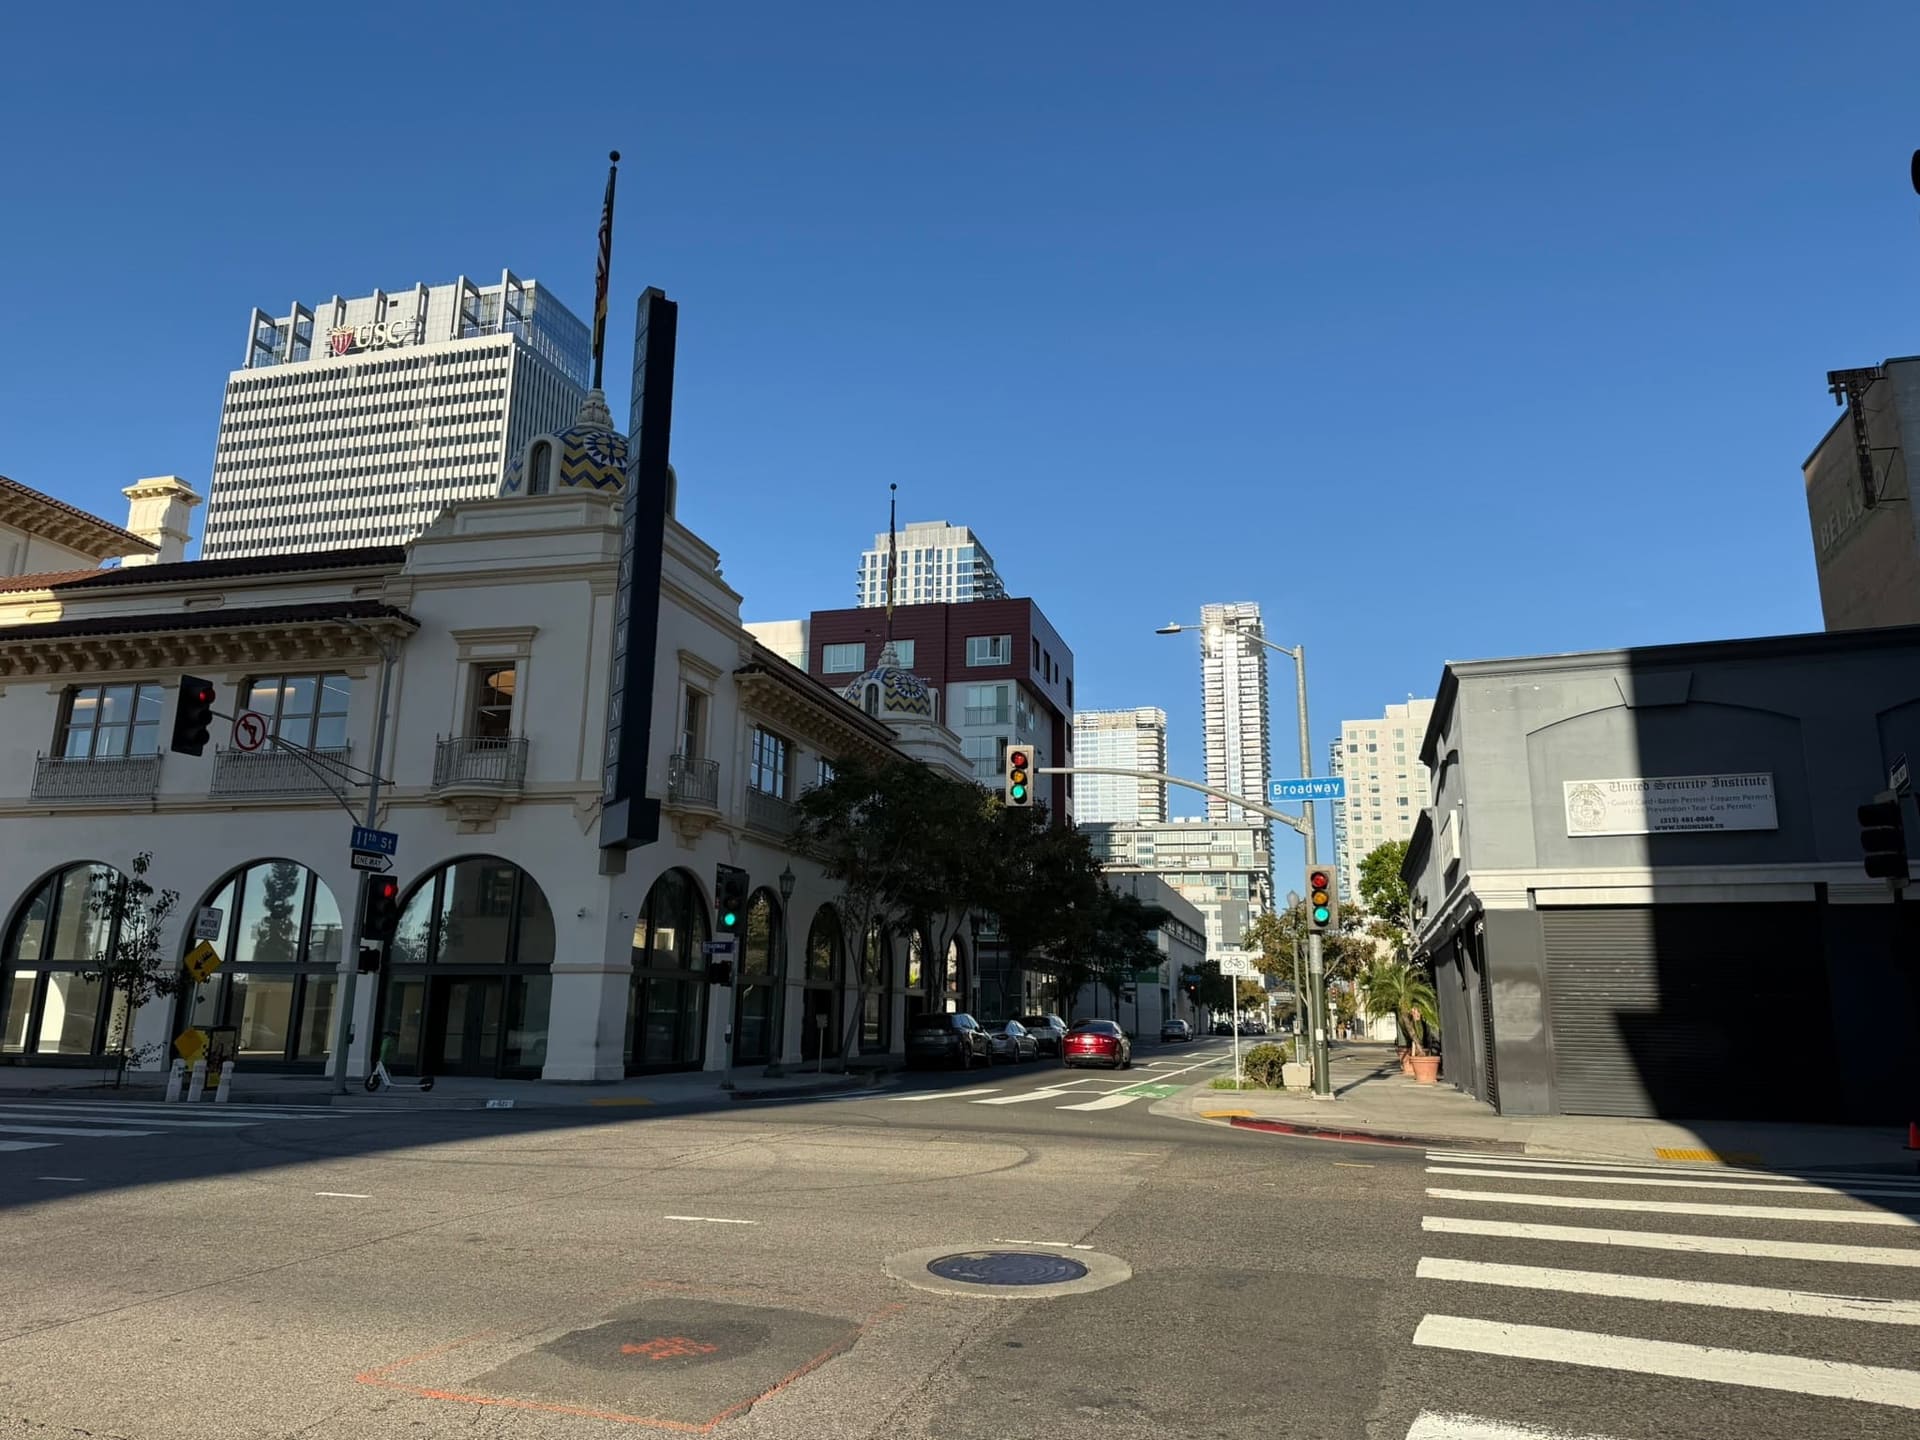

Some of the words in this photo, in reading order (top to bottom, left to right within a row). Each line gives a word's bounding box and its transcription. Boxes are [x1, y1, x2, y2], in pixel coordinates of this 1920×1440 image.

[354, 321, 406, 348] USC
[606, 526, 632, 796] EXAMINER
[1273, 782, 1339, 796] Broadway
[1608, 781, 1650, 793] United
[1654, 779, 1707, 792] Security
[1711, 776, 1767, 789] Institute
[1742, 793, 1768, 801] Permit
[1710, 803, 1724, 811] Gas
[1726, 802, 1752, 810] Permit
[356, 831, 377, 848] 11th
[380, 836, 393, 850] St
[356, 855, 368, 865] ONE
[369, 857, 382, 867] WAY
